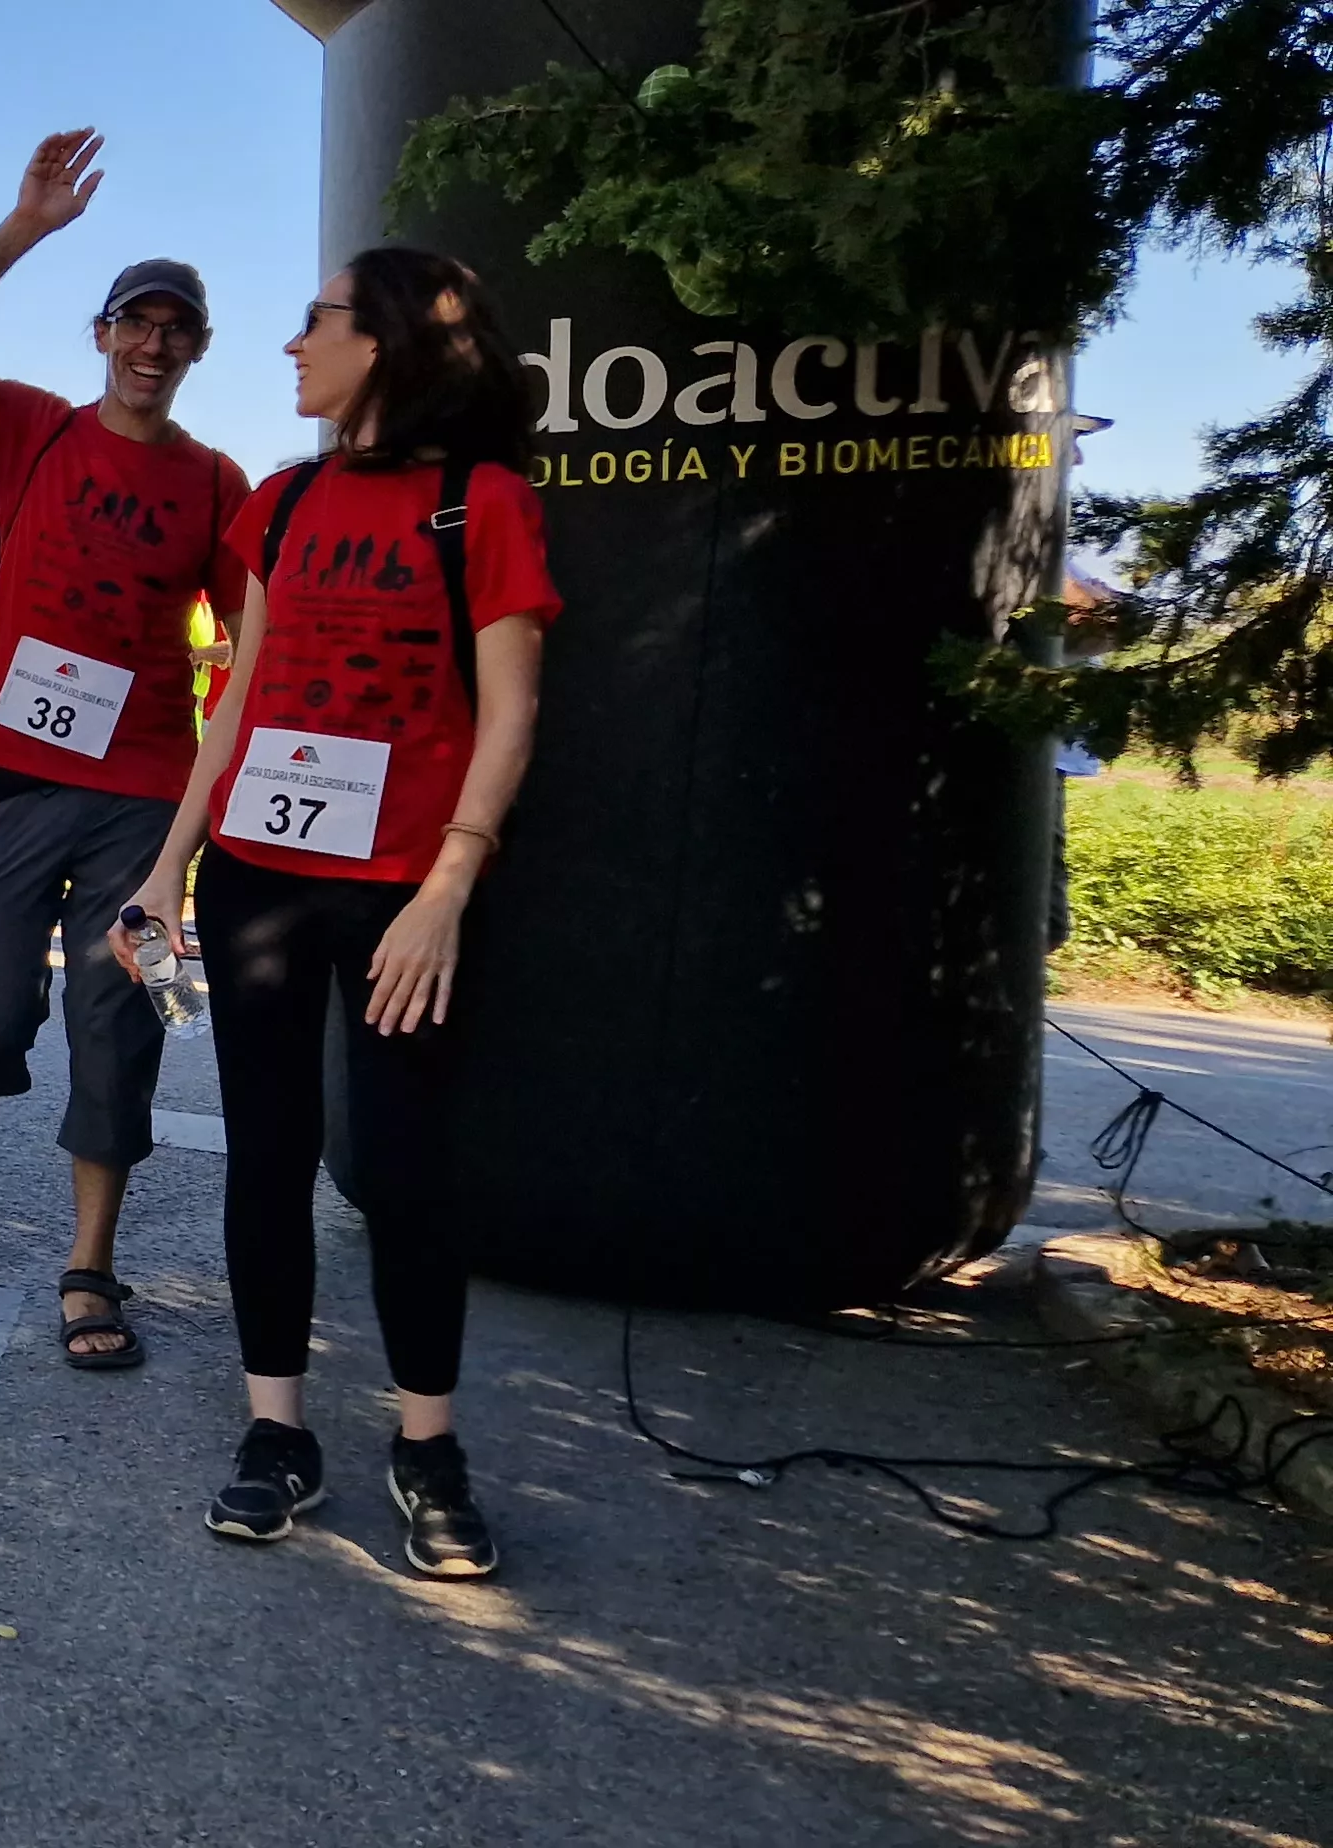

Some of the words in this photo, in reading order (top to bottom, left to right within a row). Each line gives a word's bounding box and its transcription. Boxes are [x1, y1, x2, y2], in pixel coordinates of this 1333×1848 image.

[729, 445, 756, 478] Y
[779, 424, 1053, 476] BIOMECÁNICA
[27, 697, 76, 738] 38
[288, 772, 301, 783] POR
[301, 773, 309, 785] LA
[265, 794, 327, 839] 37
